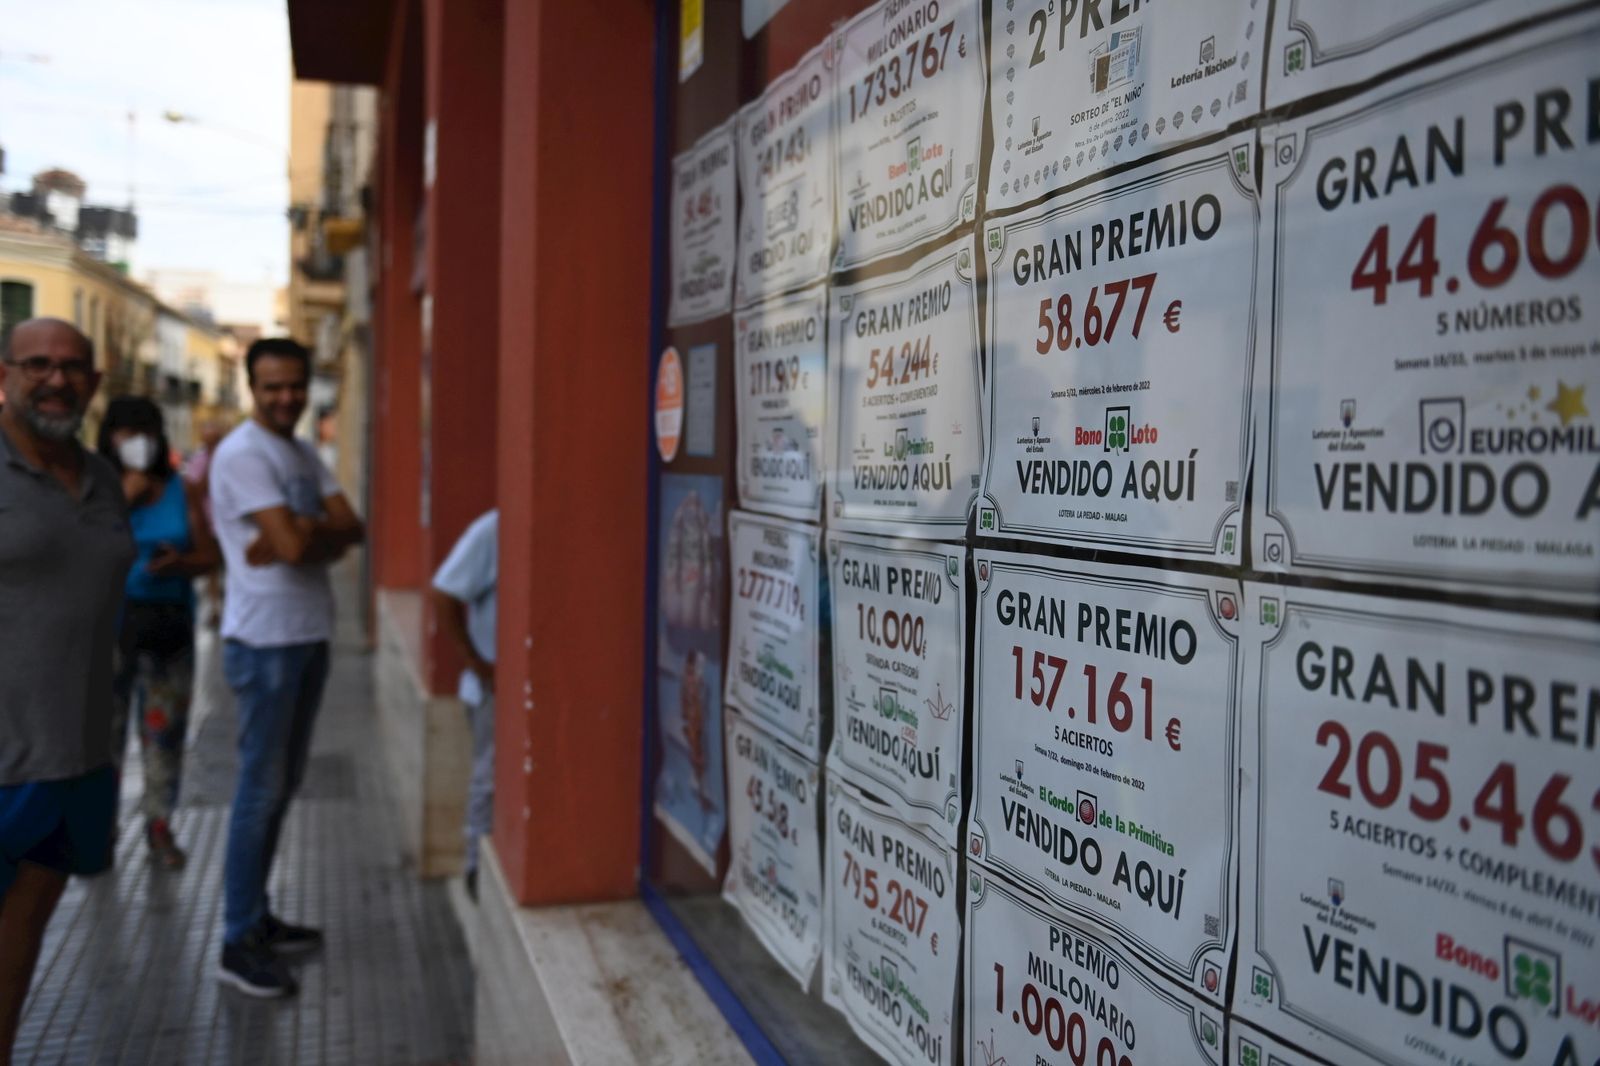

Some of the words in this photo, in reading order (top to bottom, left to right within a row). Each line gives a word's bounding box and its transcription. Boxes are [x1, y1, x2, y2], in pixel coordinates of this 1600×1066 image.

[867, 0, 939, 65] MILLONARIO
[849, 19, 955, 124] 1.733.767
[1171, 69, 1202, 88] Lotería
[1070, 107, 1100, 126] SORTEO
[1101, 102, 1109, 114] DE
[1115, 108, 1129, 121] 2022
[922, 143, 944, 162] Loto
[1316, 116, 1464, 211] GRAN
[849, 182, 914, 232] VENDIDO
[917, 149, 954, 206] AQUÍ
[1013, 230, 1082, 286] GRAN
[1091, 193, 1222, 267] PREMIO
[1351, 184, 1600, 306] 44.60
[856, 302, 904, 338] GRAN
[908, 280, 951, 327] PREMIO
[1036, 272, 1158, 355] 58.677
[1163, 300, 1183, 334] €
[1436, 316, 1448, 335] 5
[1455, 296, 1582, 334] NÚMEROS
[866, 334, 931, 389] 54.244
[1106, 384, 1112, 393] de
[1112, 383, 1132, 393] febrero
[1133, 382, 1138, 391] de
[1139, 380, 1150, 391] 2022
[1075, 426, 1102, 446] Bono
[1131, 423, 1158, 445] Loto
[853, 463, 909, 490] VENDIDO
[912, 453, 952, 492] AQUÍ
[1016, 459, 1113, 498] VENDIDO
[1121, 448, 1199, 503] AQUÍ
[1314, 461, 1550, 519] VENDIDO
[1105, 512, 1128, 522] MALAGA
[842, 558, 880, 593] GRAN
[887, 566, 941, 605] PREMIO
[857, 603, 924, 657] 10.000
[997, 589, 1065, 639] GRAN
[1077, 602, 1198, 665] PREMIO
[1012, 645, 1153, 742] 157.161
[1165, 717, 1181, 751] €
[1295, 640, 1446, 718] GRAN
[846, 713, 899, 761] VENDIDO
[901, 746, 940, 782] AQUÍ
[1054, 725, 1060, 740] 5
[1061, 727, 1114, 758] ACIERTOS
[1060, 755, 1084, 771] domingo
[1085, 762, 1092, 772] 20
[1092, 765, 1100, 776] de
[1100, 767, 1122, 782] febrero
[1123, 775, 1130, 786] de
[1131, 778, 1145, 791] 2022
[1315, 720, 1600, 876] 205.46
[1039, 785, 1046, 802] El
[1047, 790, 1075, 815] Gordo
[1099, 810, 1113, 829] de
[1116, 815, 1126, 835] la
[1128, 821, 1175, 857] Primitiva
[1329, 811, 1339, 830] 5
[1343, 815, 1437, 859] ACIERTOS
[838, 808, 875, 858] GRAN
[882, 835, 945, 898] PREMIO
[1000, 796, 1102, 876] VENDIDO
[1112, 850, 1187, 921] AQUÍ
[843, 850, 929, 938] 795.207
[1061, 878, 1069, 888] LA
[1070, 881, 1092, 897] PIEDAD
[1096, 892, 1121, 911] MALAGA
[1049, 926, 1119, 990] PREMIO
[1436, 931, 1499, 982] Bono
[847, 962, 902, 1027] VENDIDO
[907, 1015, 942, 1066] AQUÍ
[1028, 951, 1136, 1050] MILLONARIO
[1302, 924, 1528, 1061] VENDIDO
